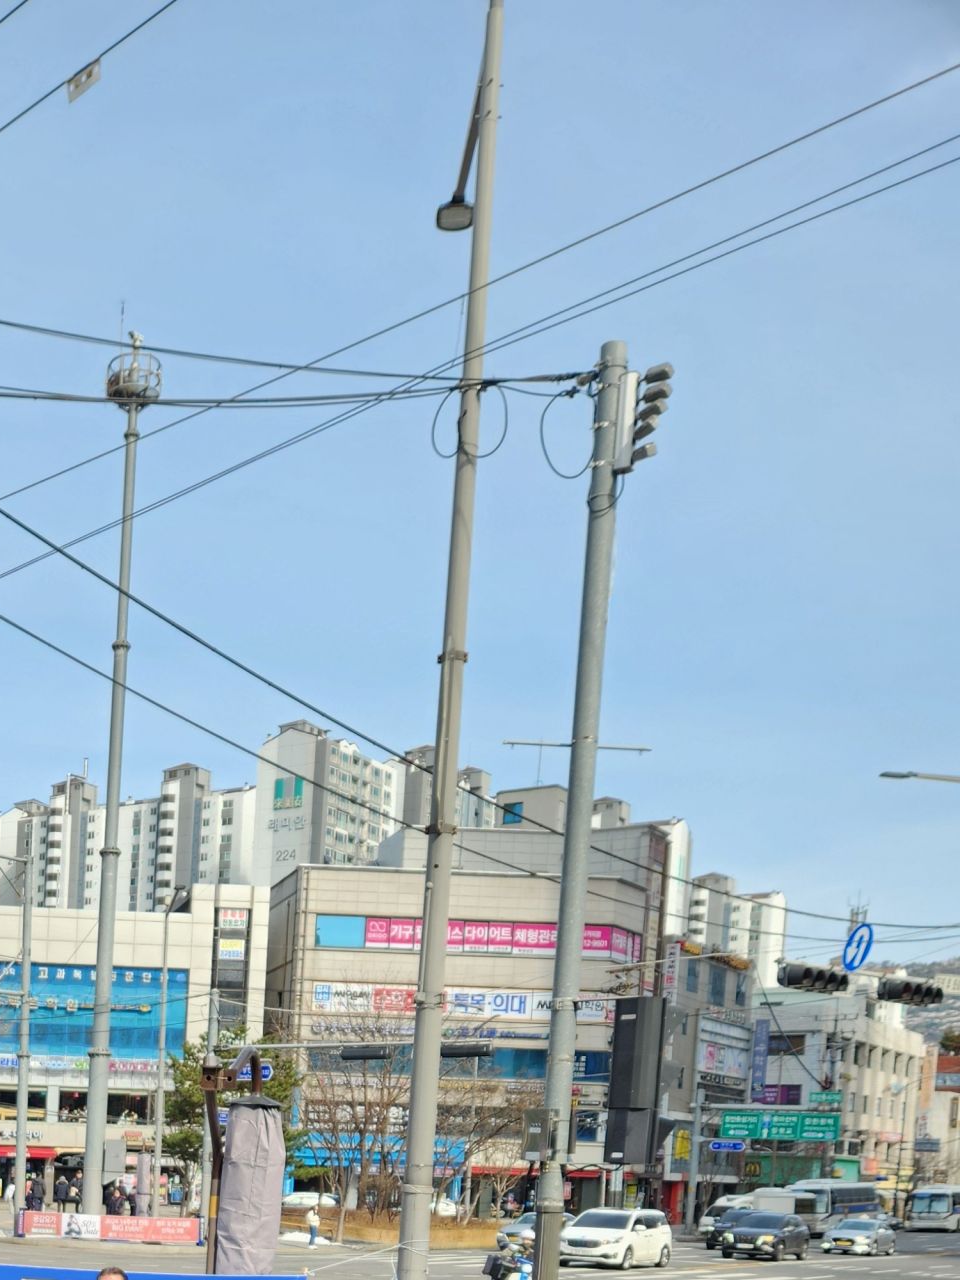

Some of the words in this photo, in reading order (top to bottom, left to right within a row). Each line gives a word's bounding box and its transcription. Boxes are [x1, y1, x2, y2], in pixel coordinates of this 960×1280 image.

[267, 815, 306, 833] 래미안
[275, 849, 296, 862] 224
[465, 926, 513, 943] 다이어트
